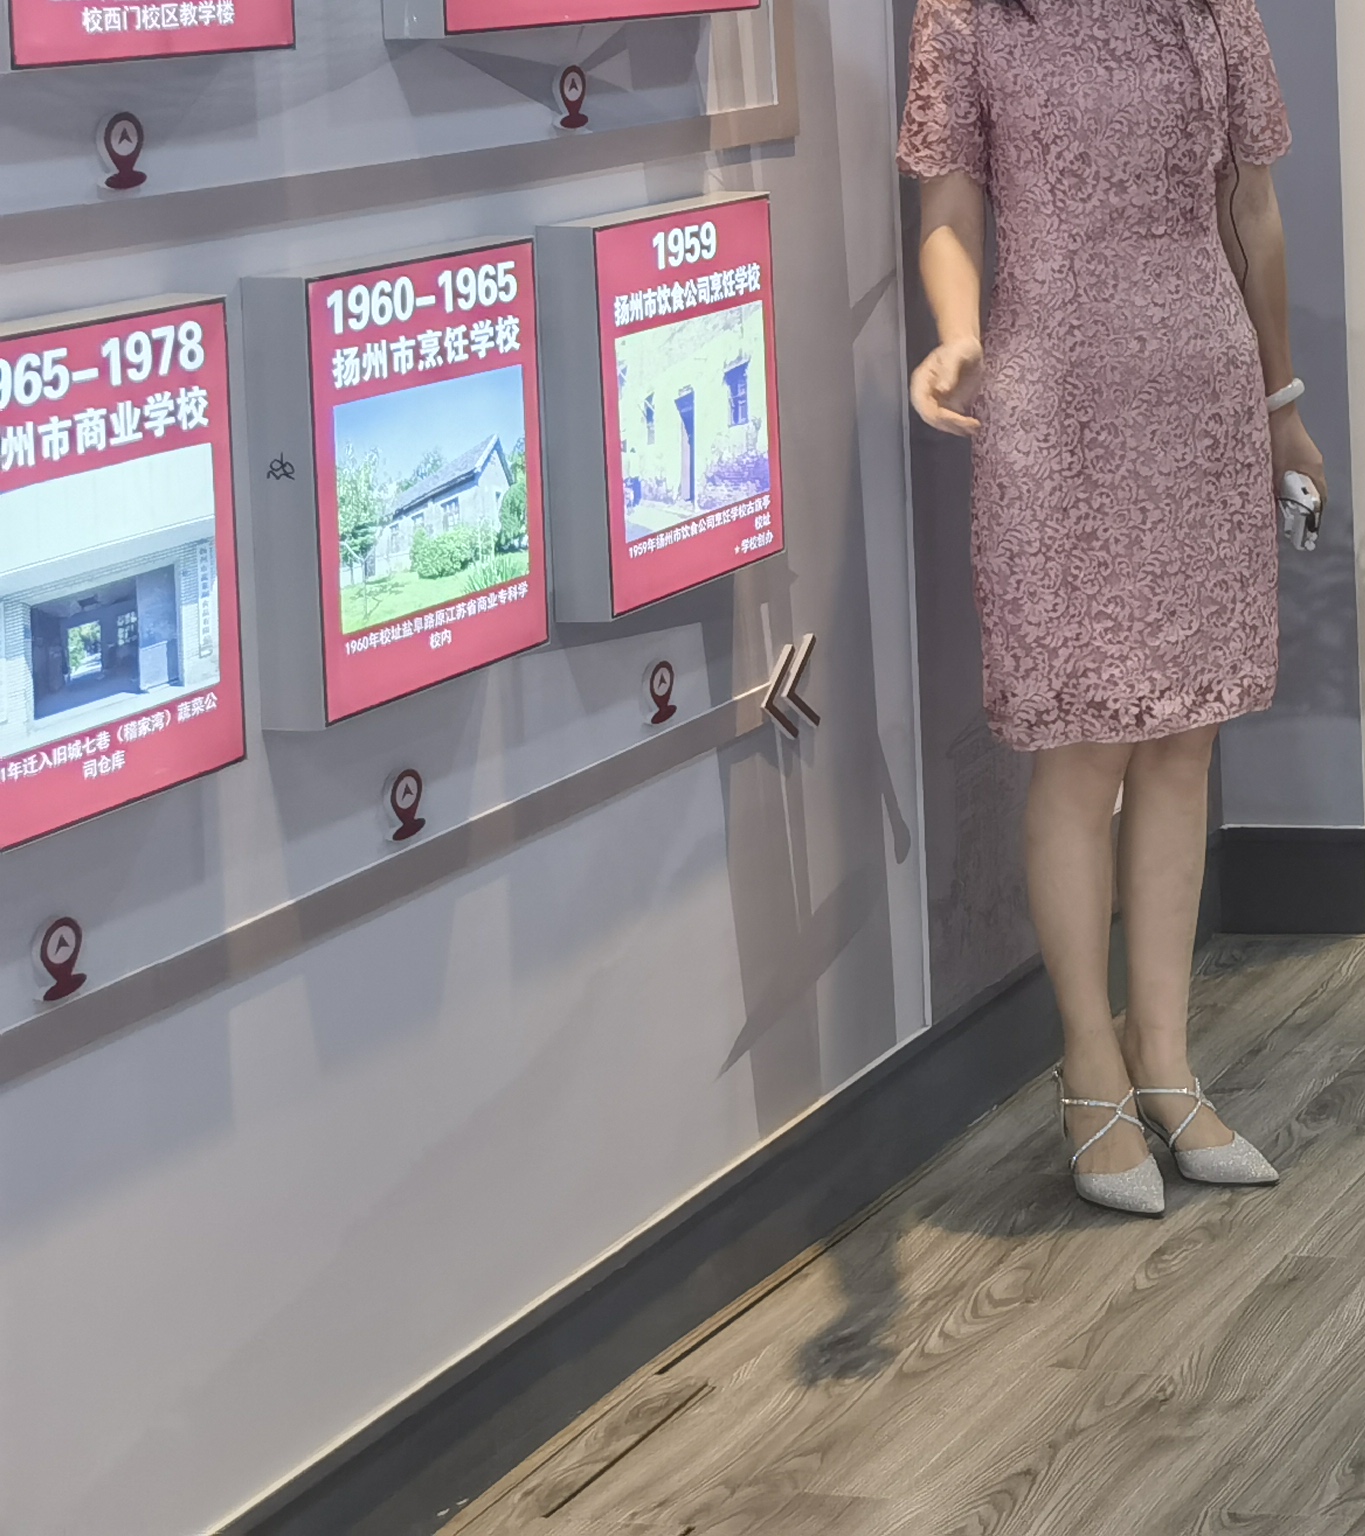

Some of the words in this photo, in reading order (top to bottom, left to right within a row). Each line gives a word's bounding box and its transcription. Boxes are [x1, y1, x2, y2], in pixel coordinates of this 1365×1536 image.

[82, 0, 236, 33] 校西门校区教学楼
[652, 221, 718, 270] 1959
[326, 260, 518, 335] 1960-1965
[613, 262, 762, 326] 扬州市饮食公司烹饪学校
[332, 315, 521, 389] 扬州市烹饪学校
[755, 512, 772, 530] 校址
[429, 630, 453, 650] 校内
[83, 751, 126, 779] 司仓库
